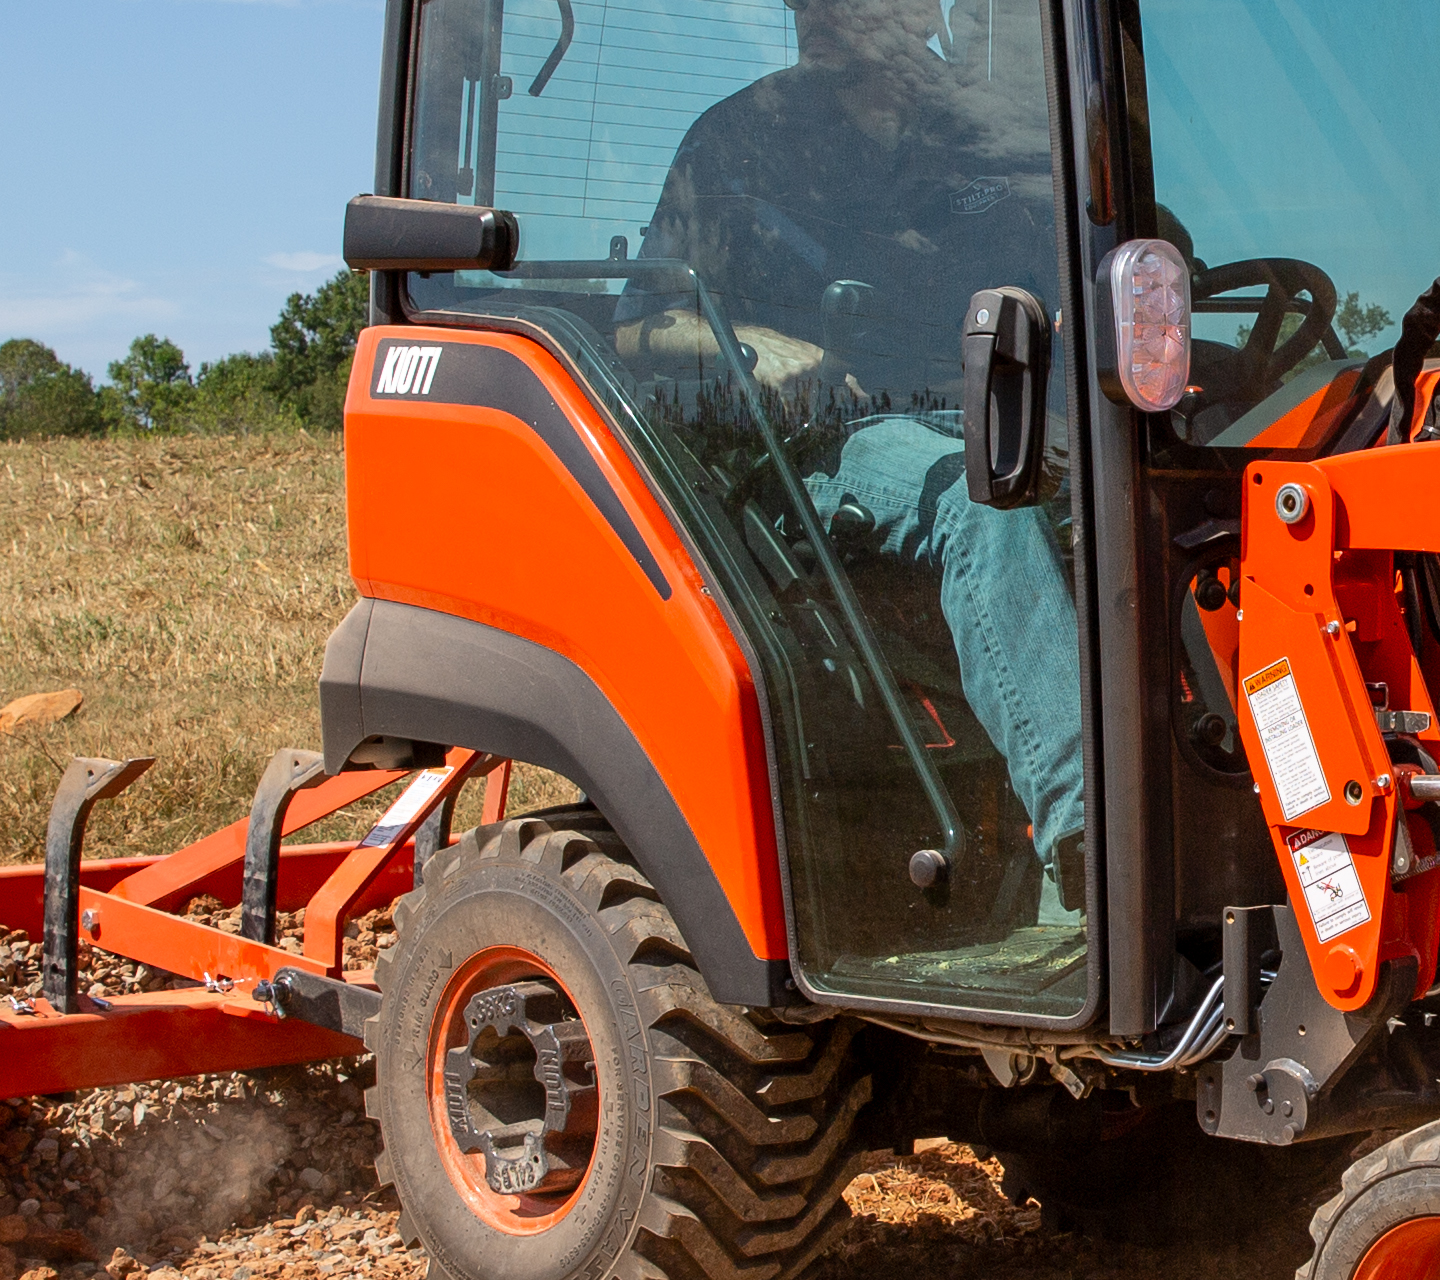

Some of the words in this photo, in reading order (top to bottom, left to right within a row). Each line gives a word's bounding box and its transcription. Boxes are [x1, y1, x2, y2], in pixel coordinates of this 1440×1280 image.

[376, 345, 443, 395] KIOTI
[1254, 665, 1286, 684] WARNING
[1255, 687, 1272, 700] LOADER
[411, 1007, 424, 1040] RIM
[418, 963, 440, 1011] GUARD
[606, 972, 653, 1192] GARDEN
